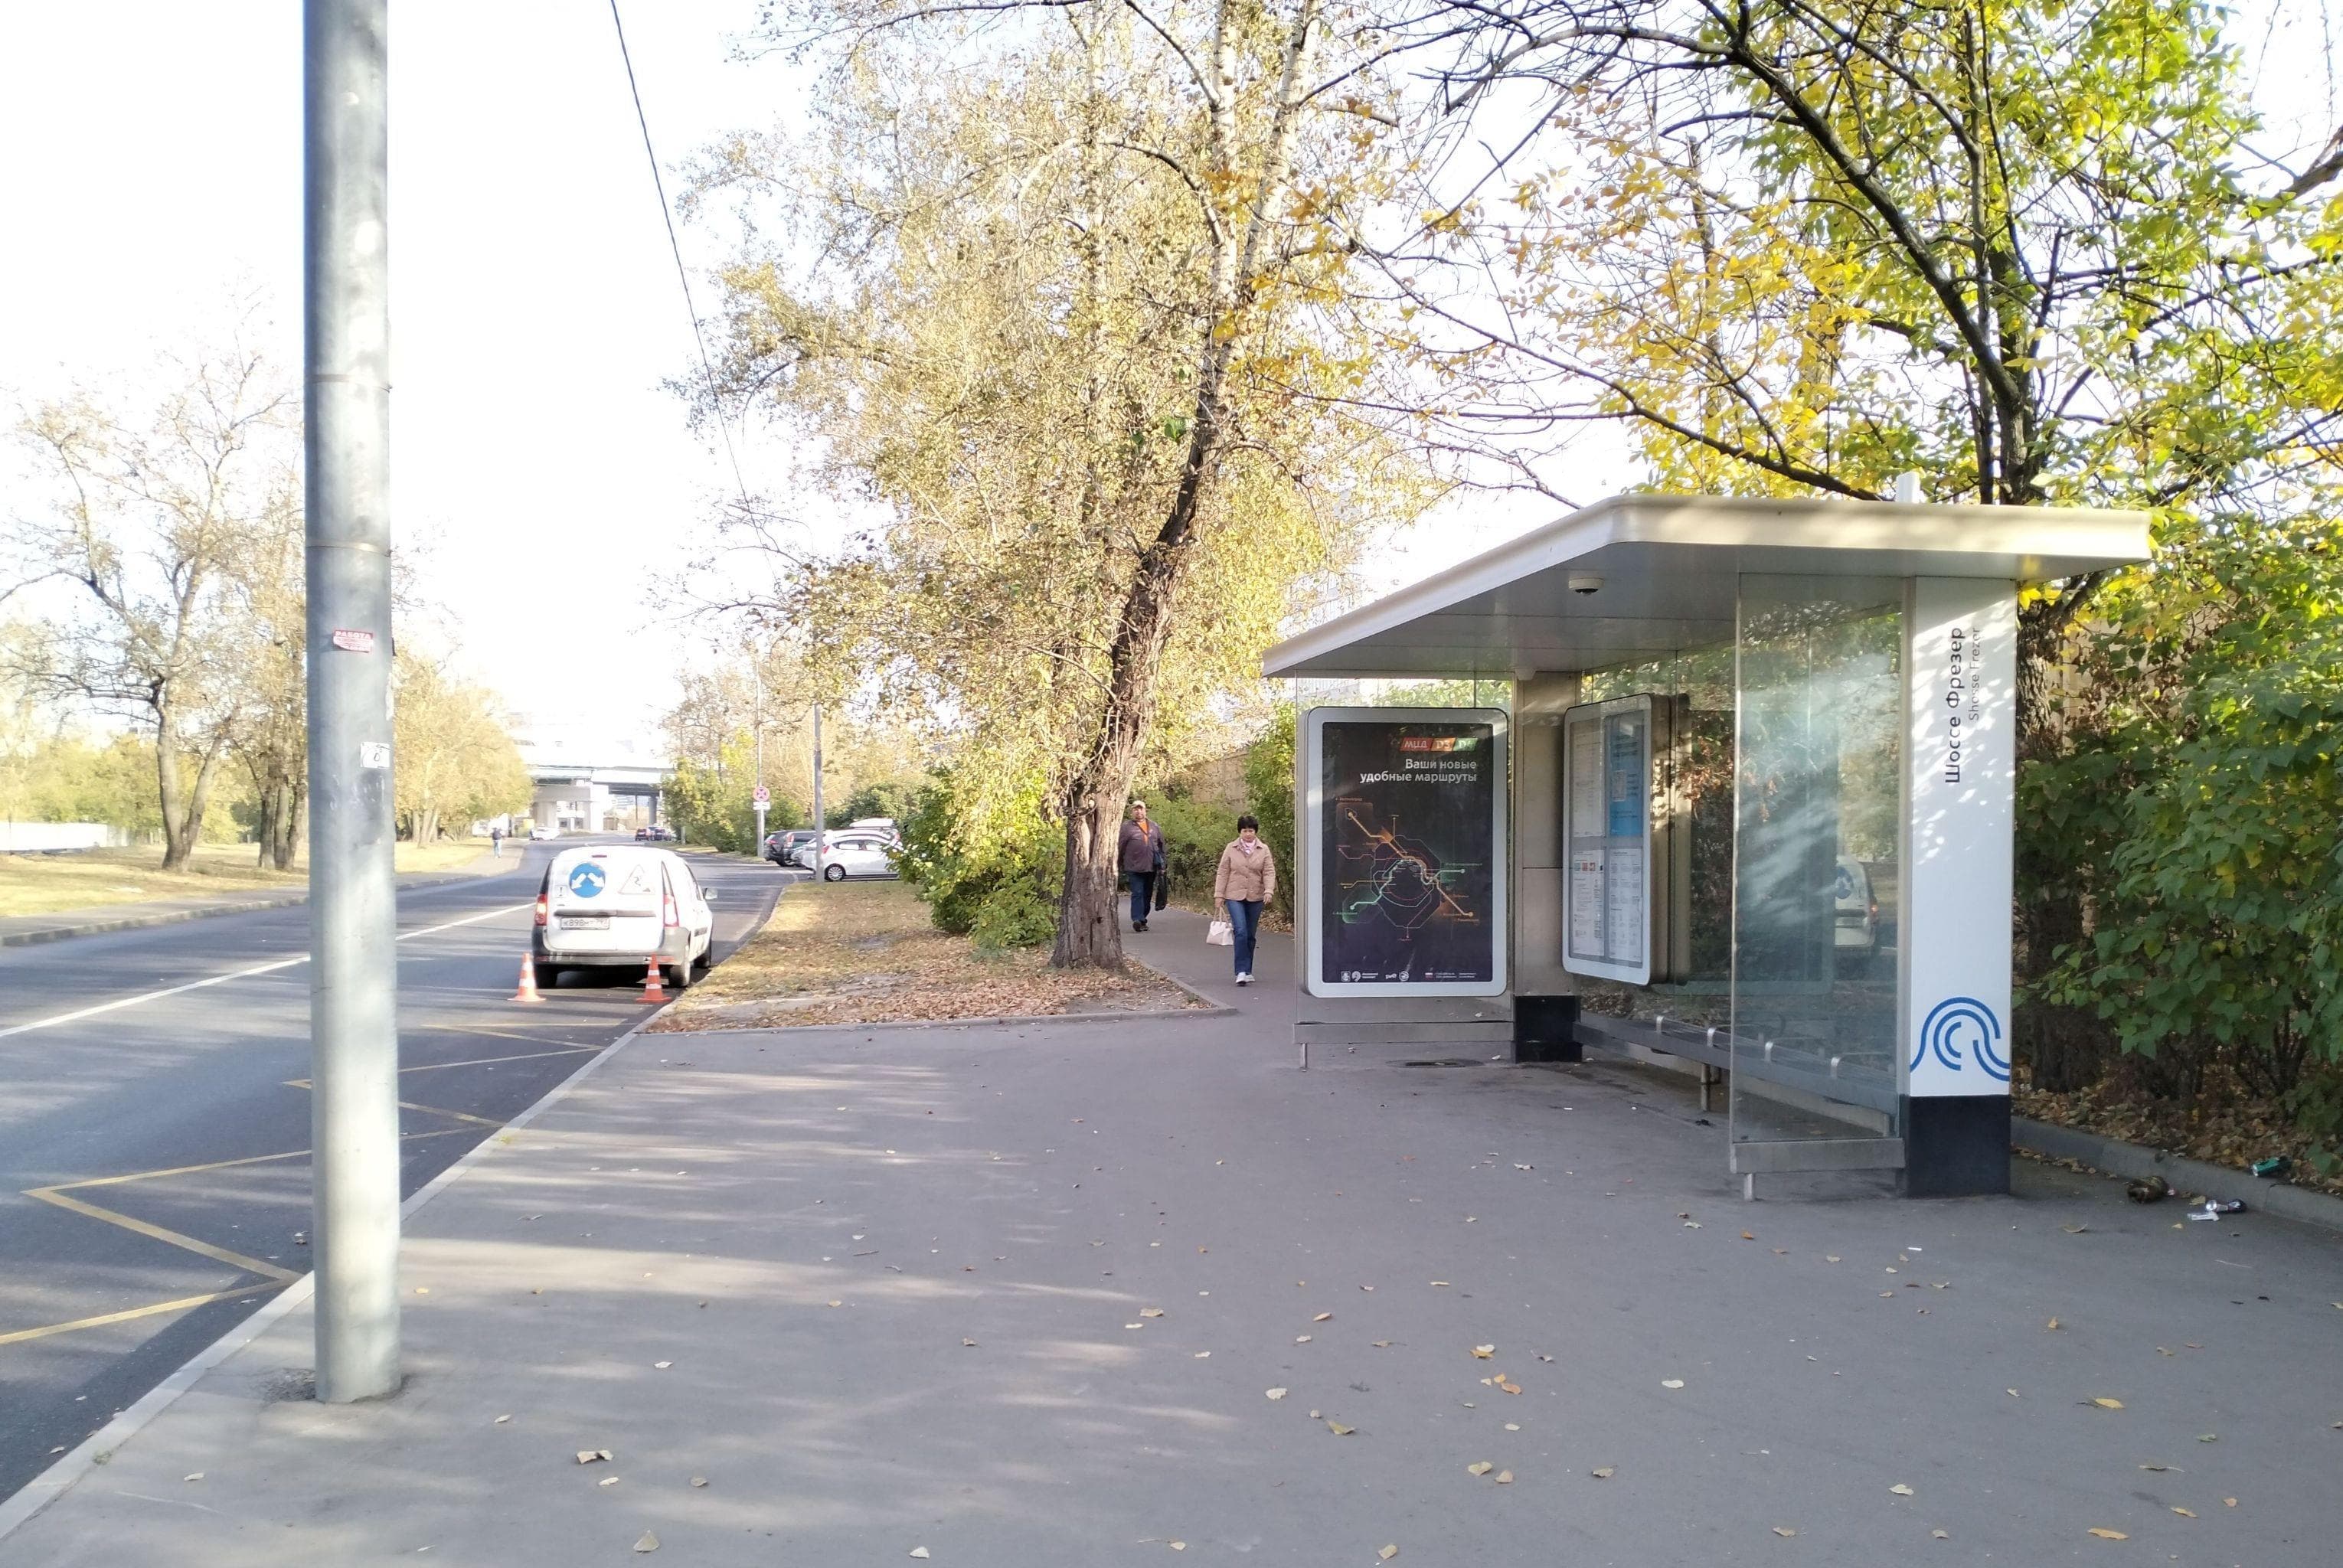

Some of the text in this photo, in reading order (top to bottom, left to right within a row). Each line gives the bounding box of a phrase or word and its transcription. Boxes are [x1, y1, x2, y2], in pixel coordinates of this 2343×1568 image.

[1969, 627, 1981, 720] Shosse Frezer
[1945, 627, 1966, 783] Шоссе Фрезер
[1404, 740, 1429, 750] МЦД
[1436, 740, 1451, 749] D3
[1405, 758, 1477, 769] Ваши новые
[1360, 770, 1477, 783] удобные маршруты
